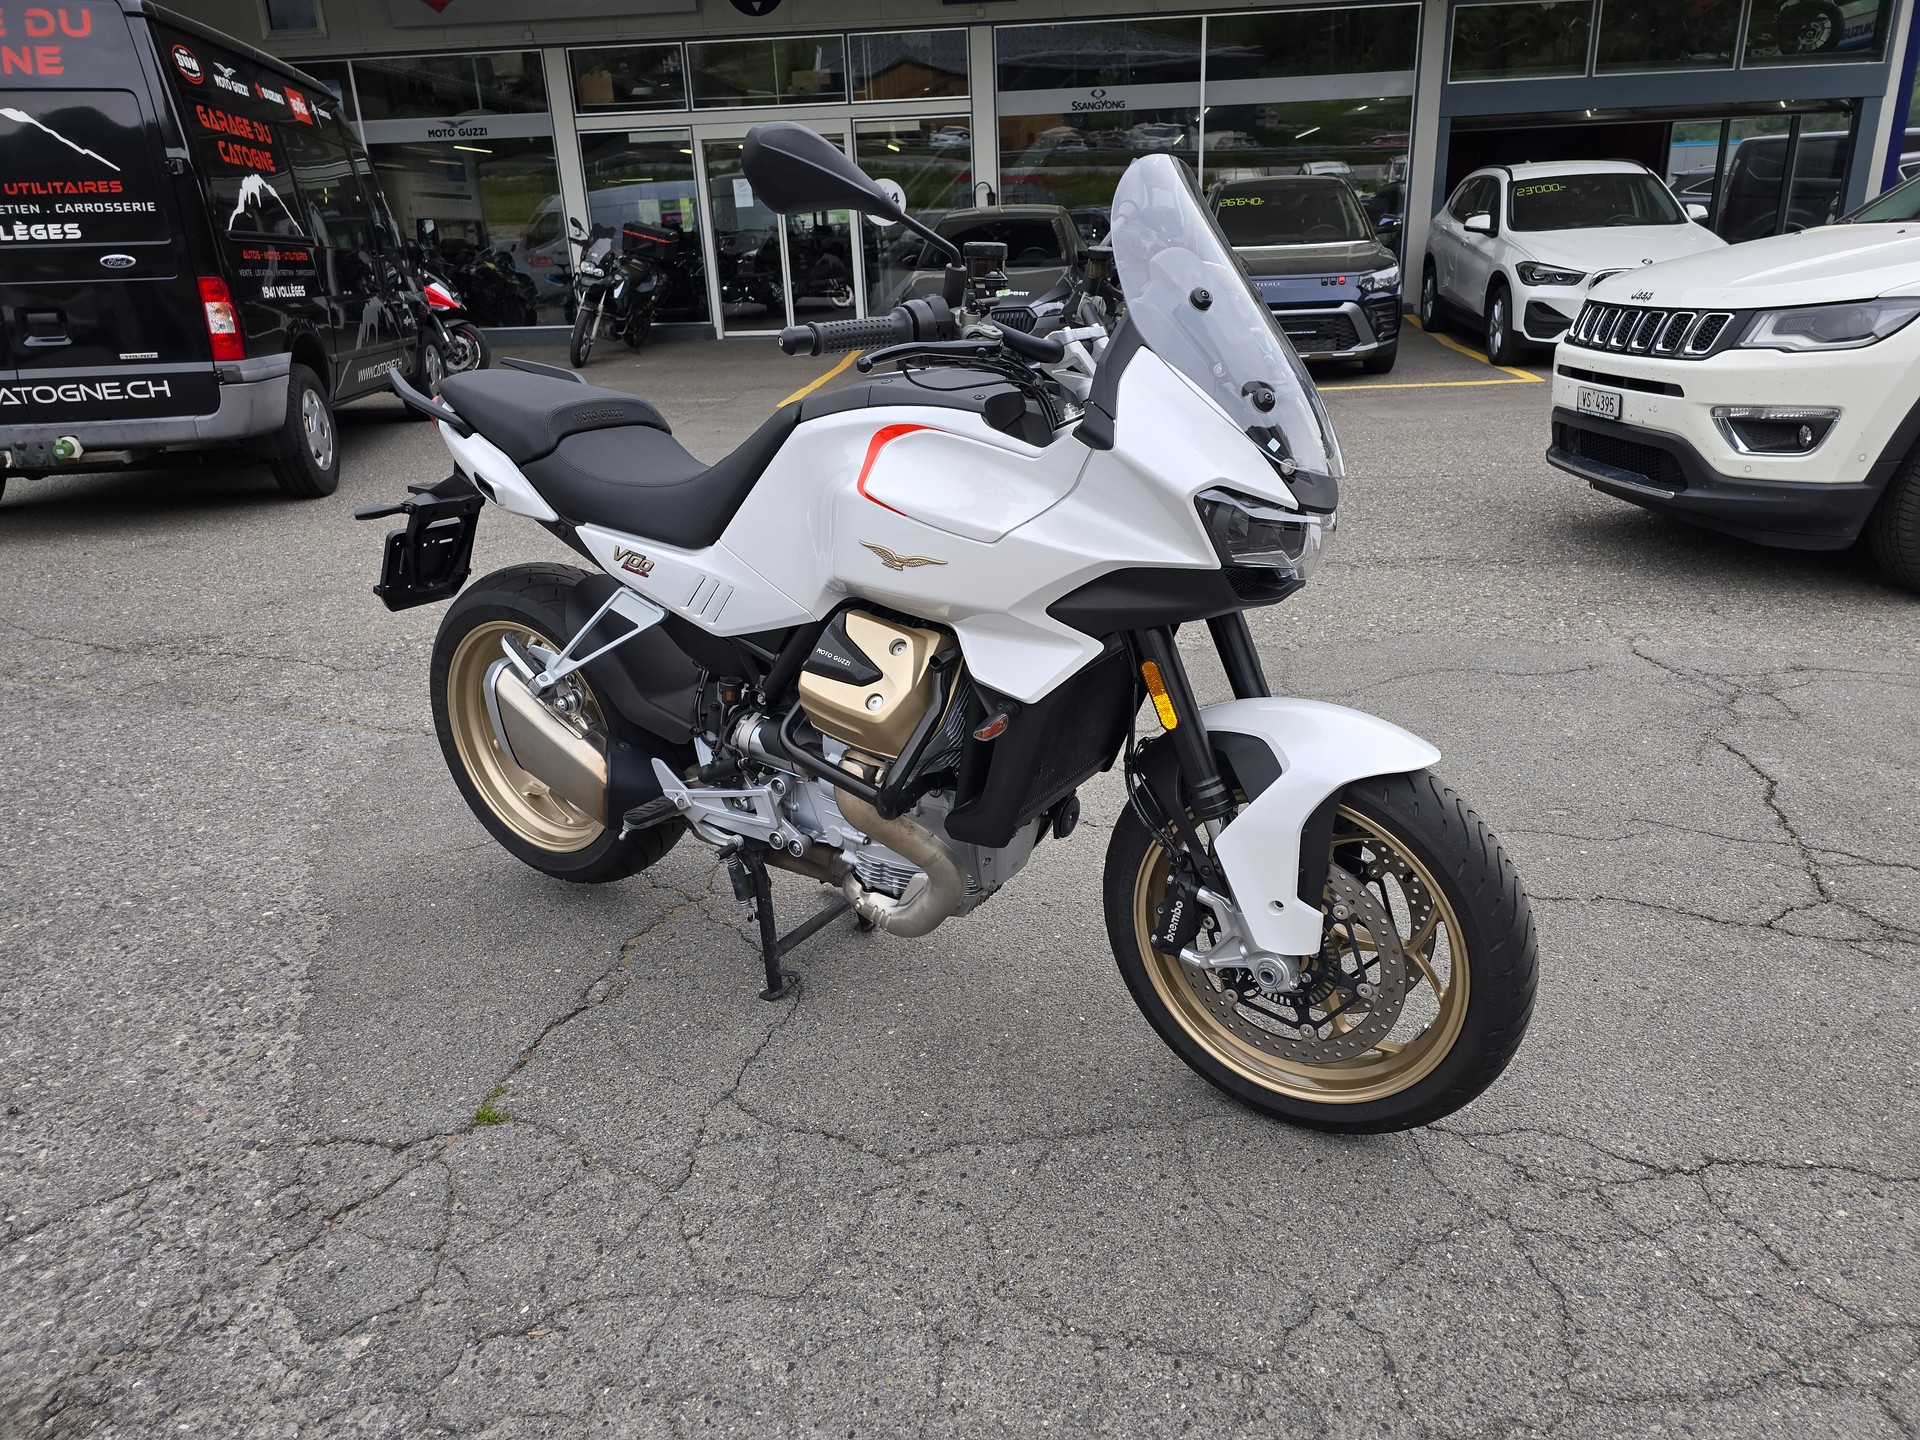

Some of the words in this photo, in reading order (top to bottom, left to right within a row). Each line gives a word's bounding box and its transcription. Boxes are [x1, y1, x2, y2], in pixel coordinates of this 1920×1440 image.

[25, 8, 92, 38] DU
[213, 74, 231, 90] MOTO
[231, 80, 250, 97] GUZZI
[262, 87, 285, 105] SUZUKI
[196, 105, 254, 140] GARAGE
[253, 120, 272, 144] DU
[428, 129, 455, 138] MOTO
[458, 127, 488, 137] GUZZI
[218, 140, 276, 172] CATOGNE
[4, 181, 124, 195] UTILITAIRES
[56, 202, 156, 213] CARROSSERIE
[261, 286, 277, 299] 1941
[276, 283, 306, 298] VOLLÈGES
[1631, 289, 1654, 302] Jeep
[0, 380, 172, 405] ATOGNE.CH
[1582, 391, 1591, 408] VS
[1595, 394, 1615, 413] 4395
[574, 411, 599, 424] MOTO
[600, 409, 624, 420] GUZZI
[614, 544, 655, 572] V100
[816, 647, 833, 659] MOTO
[833, 655, 851, 667] GUZZI
[1163, 900, 1184, 943] brembo
